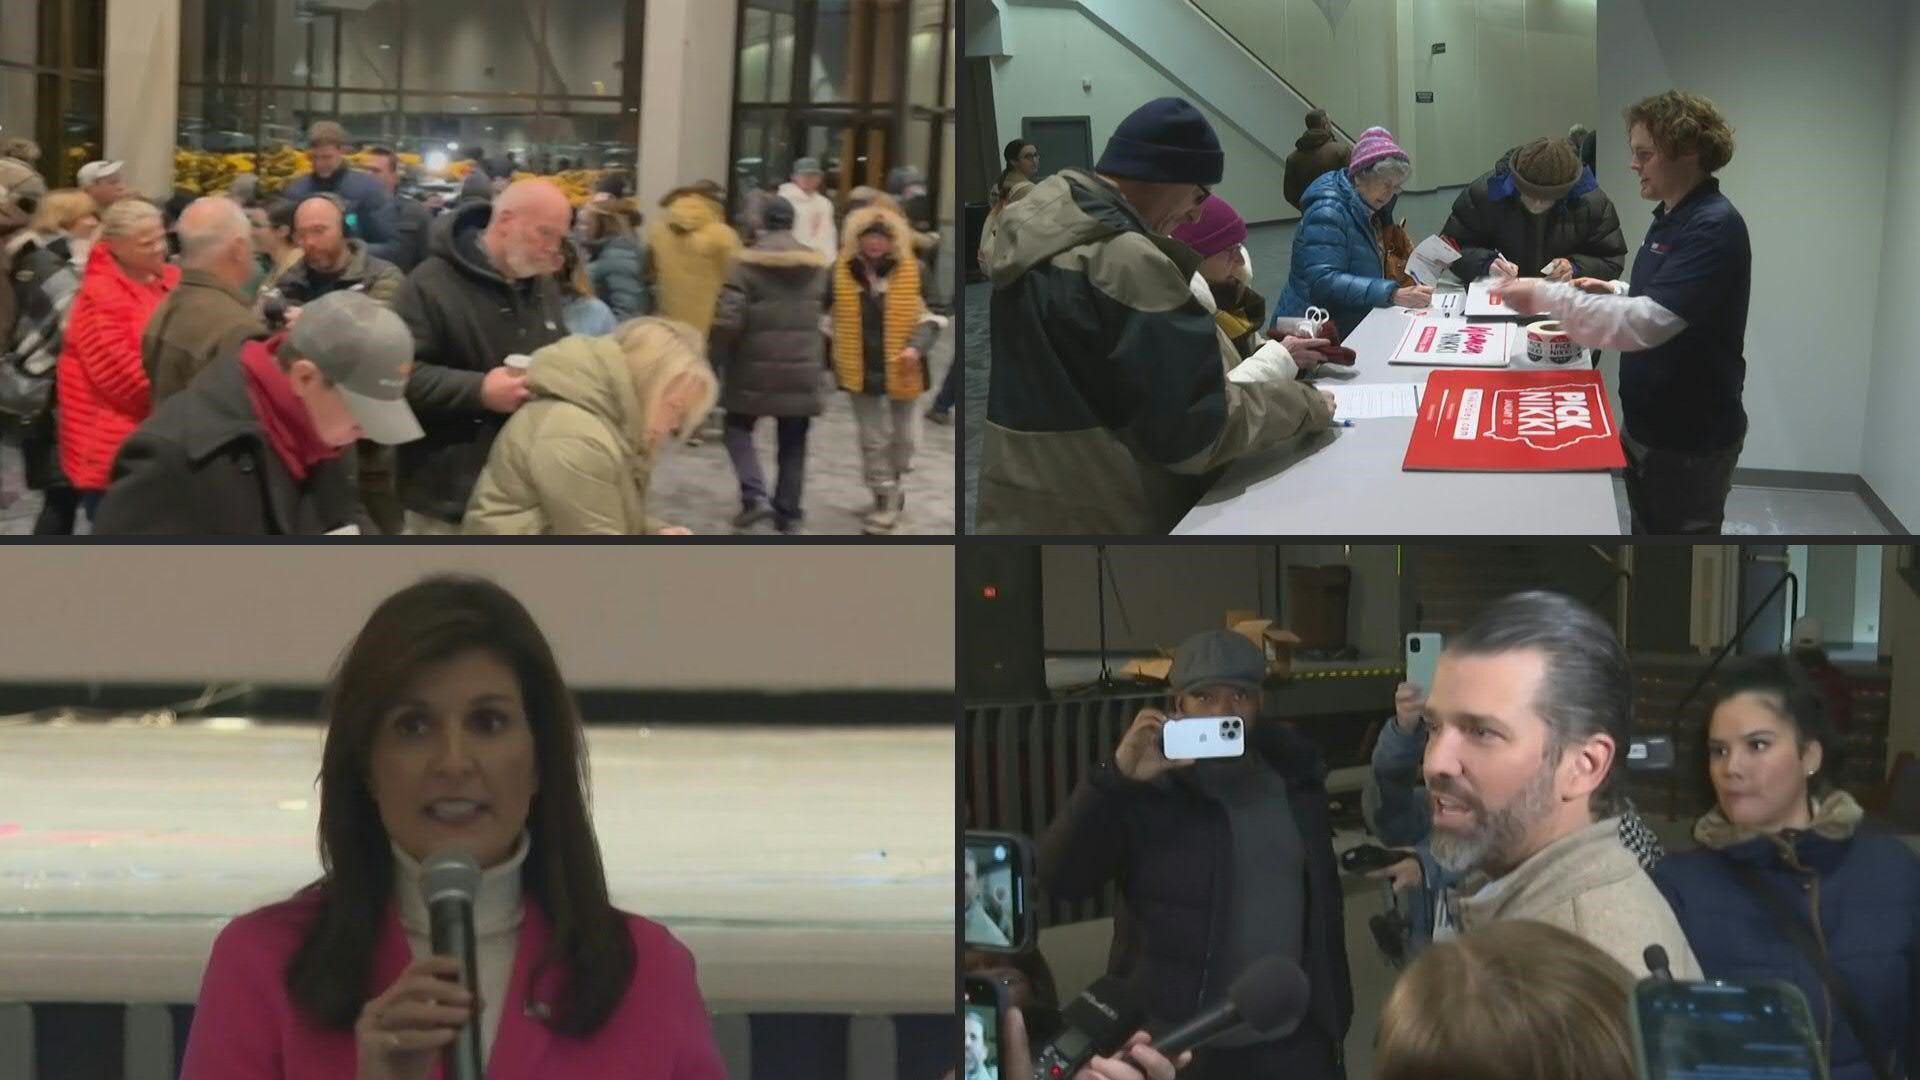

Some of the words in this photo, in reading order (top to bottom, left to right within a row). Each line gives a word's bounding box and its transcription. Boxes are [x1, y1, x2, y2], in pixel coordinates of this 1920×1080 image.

[1504, 399, 1513, 417] JANUARY
[1518, 390, 1556, 435] NIKKI
[1554, 391, 1592, 430] PICK
